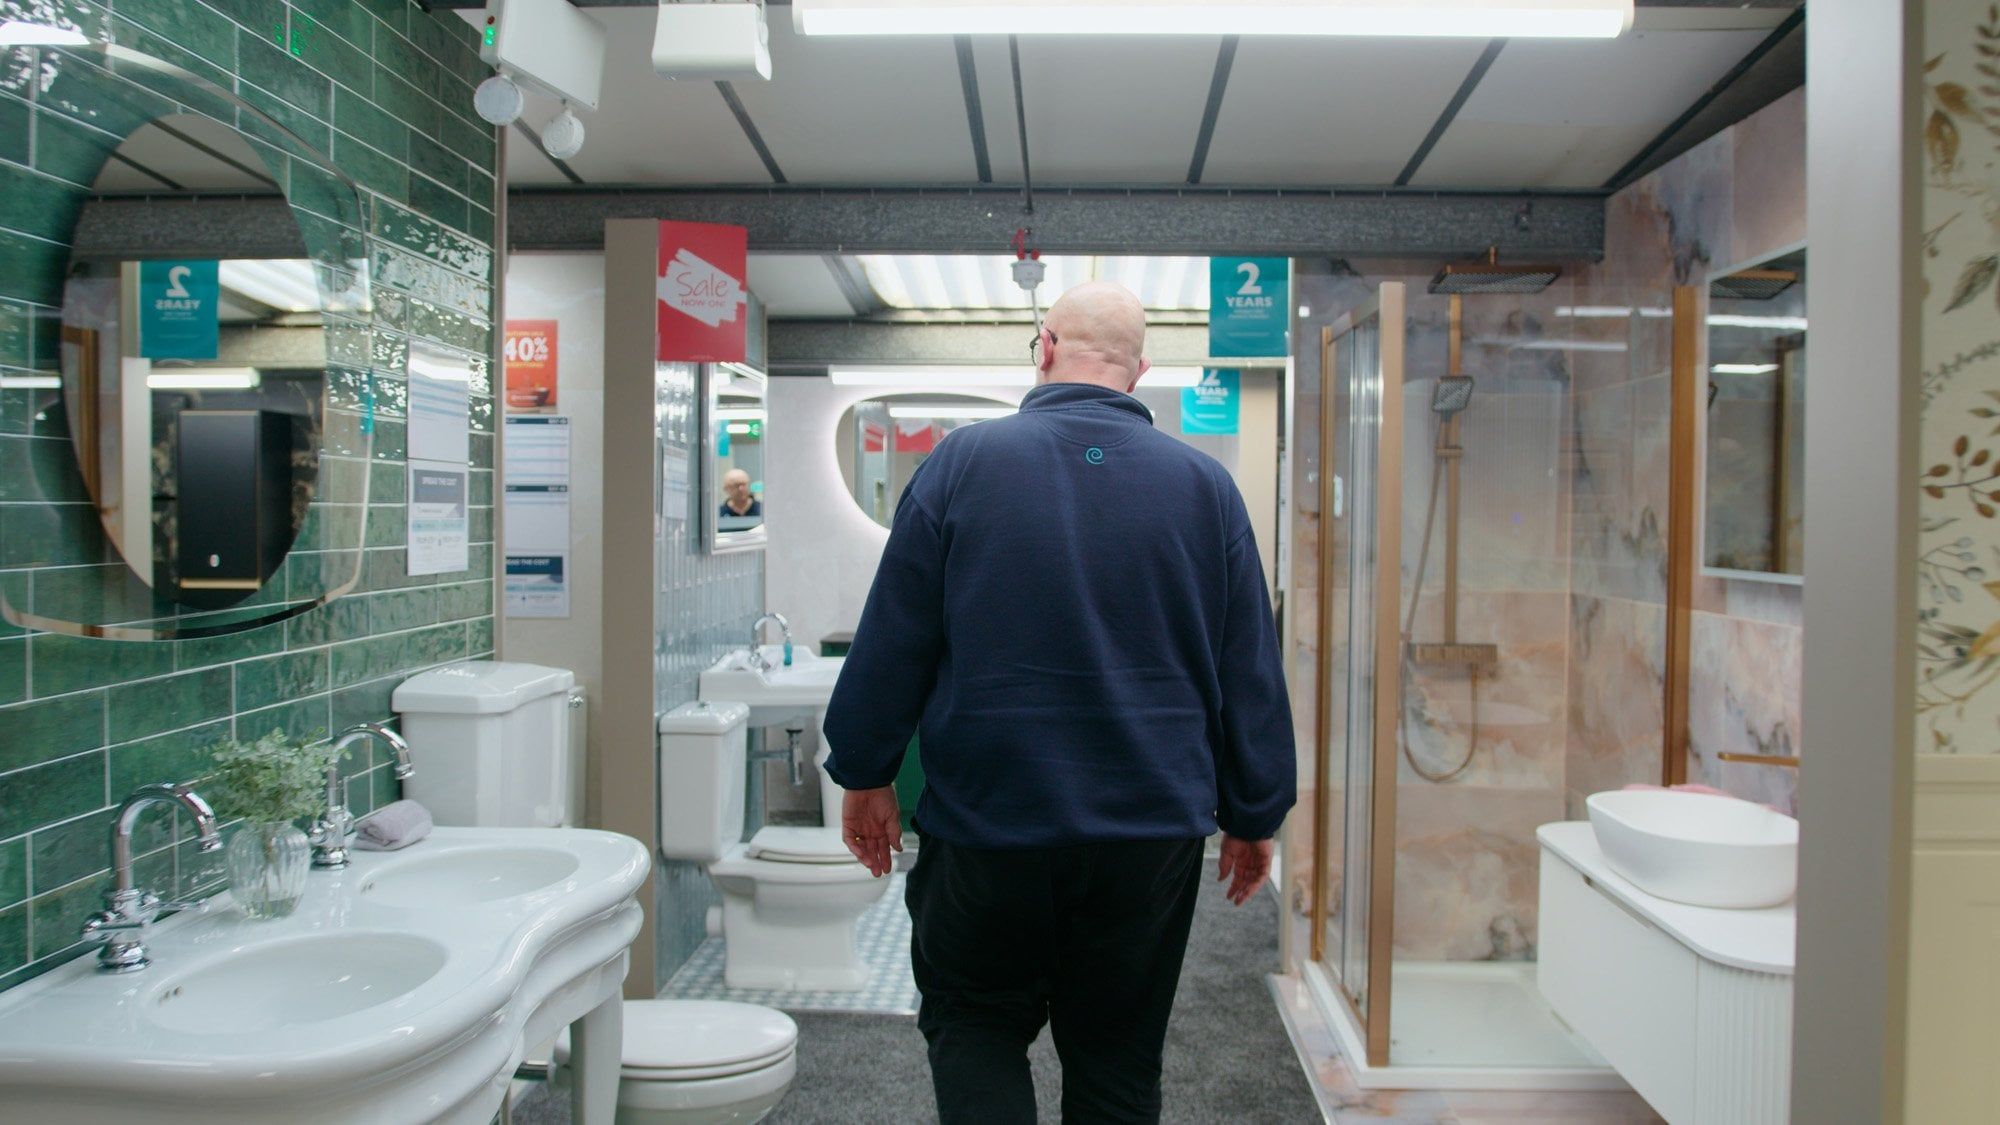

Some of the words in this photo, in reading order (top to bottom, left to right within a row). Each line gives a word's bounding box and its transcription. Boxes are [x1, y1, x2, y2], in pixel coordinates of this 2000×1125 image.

[676, 271, 728, 297] Sale
[1237, 262, 1262, 295] 2
[1225, 296, 1273, 307] YEARS
[1193, 387, 1228, 396] YEARS
